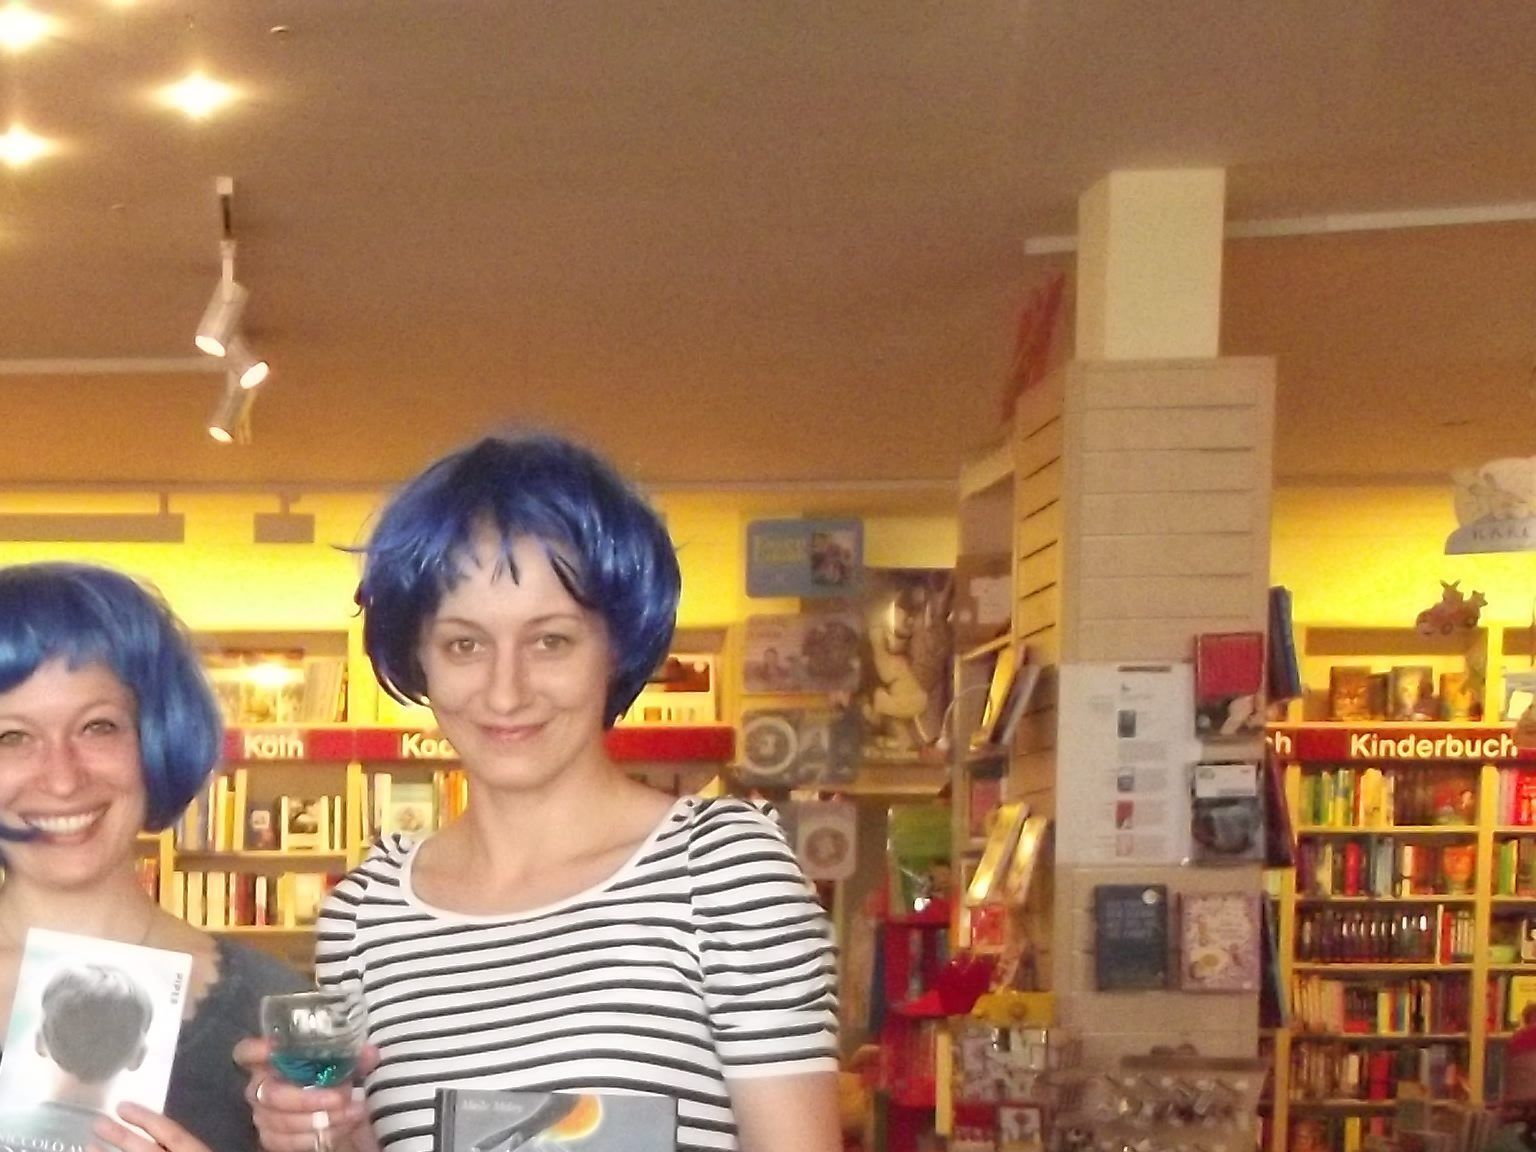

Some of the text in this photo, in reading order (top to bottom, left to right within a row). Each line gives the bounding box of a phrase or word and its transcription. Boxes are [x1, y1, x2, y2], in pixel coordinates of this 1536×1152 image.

[243, 731, 305, 760] Köln
[401, 732, 461, 759] Koc
[1350, 732, 1518, 759] Kinderbuch
